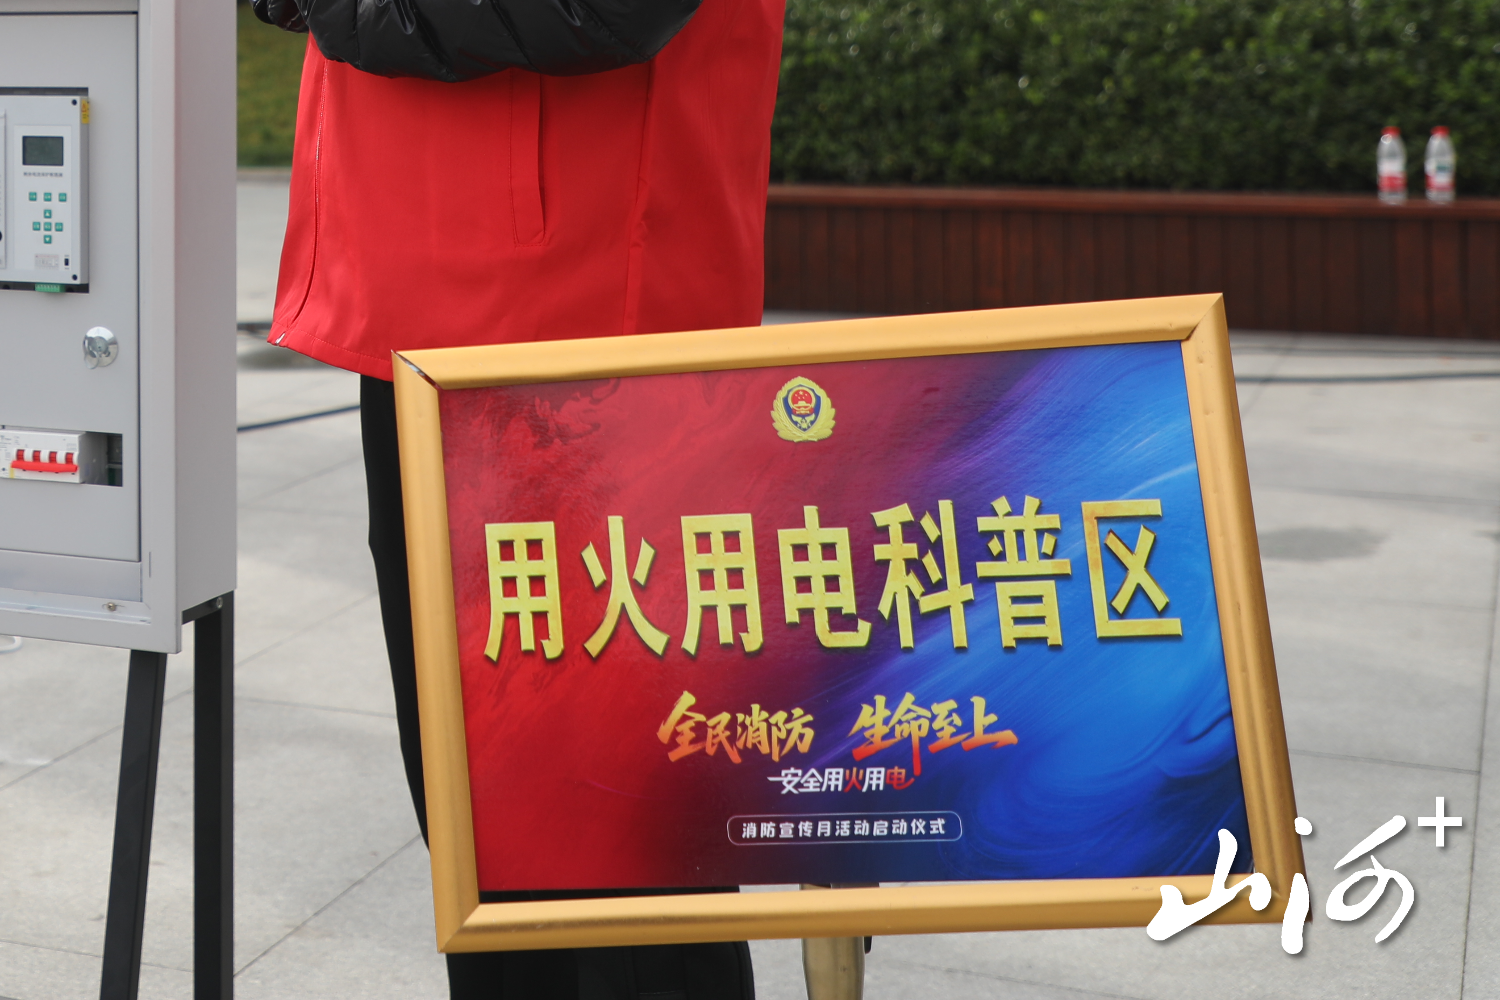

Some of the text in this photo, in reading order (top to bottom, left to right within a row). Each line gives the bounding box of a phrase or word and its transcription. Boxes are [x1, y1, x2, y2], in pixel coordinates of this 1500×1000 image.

[483, 495, 1183, 663] 用火用电科普区
[657, 690, 1019, 777] 全民消防 生命至上
[767, 765, 915, 795] 安全用火用电
[741, 817, 947, 840] 消防宣传月活动启动仪式
